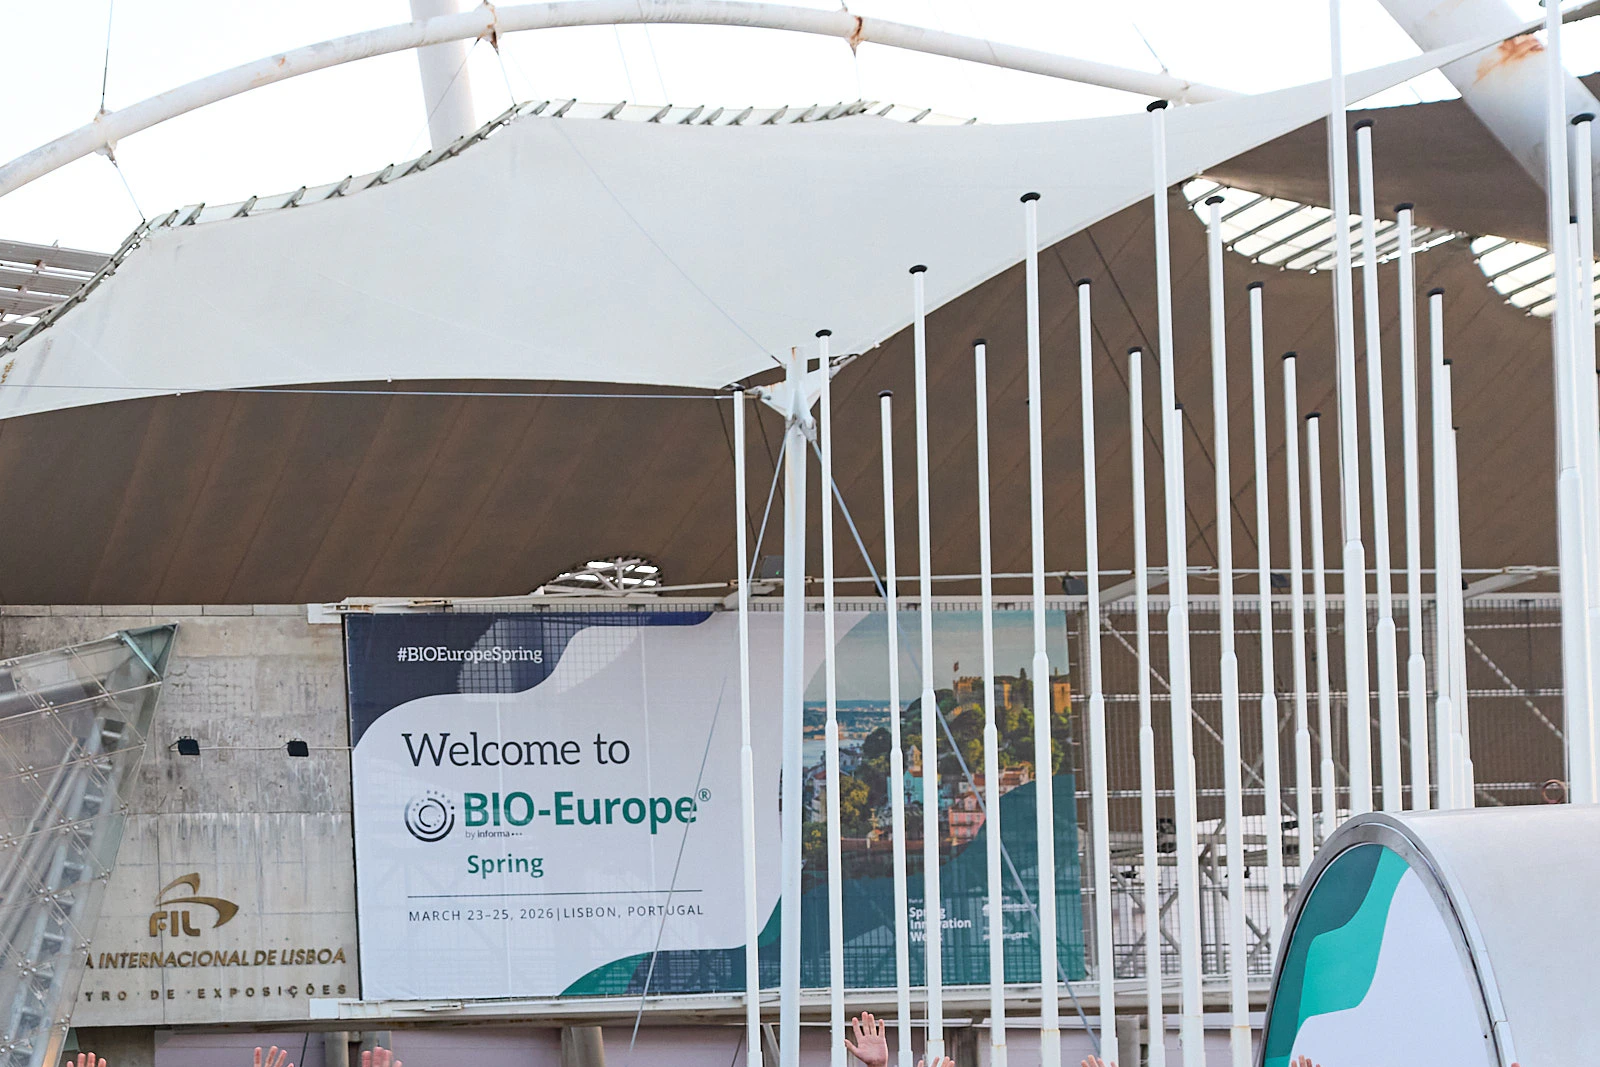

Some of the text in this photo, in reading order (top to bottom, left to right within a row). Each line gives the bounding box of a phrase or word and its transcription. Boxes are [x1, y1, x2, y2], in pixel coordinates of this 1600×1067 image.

[397, 646, 543, 664] #BIOEuropeSpring
[401, 731, 631, 767] Welcome to
[477, 829, 510, 838] informa
[467, 854, 544, 879] Spring
[409, 910, 461, 921] MARCH
[628, 905, 704, 917] PORTUGAL
[149, 910, 200, 937] FIL
[99, 950, 249, 969] INTERNACIONAL
[253, 950, 276, 966] DE
[281, 948, 346, 965] LISBOA
[150, 989, 175, 1000] DE
[197, 983, 347, 999] EXPOSIÇÕES
